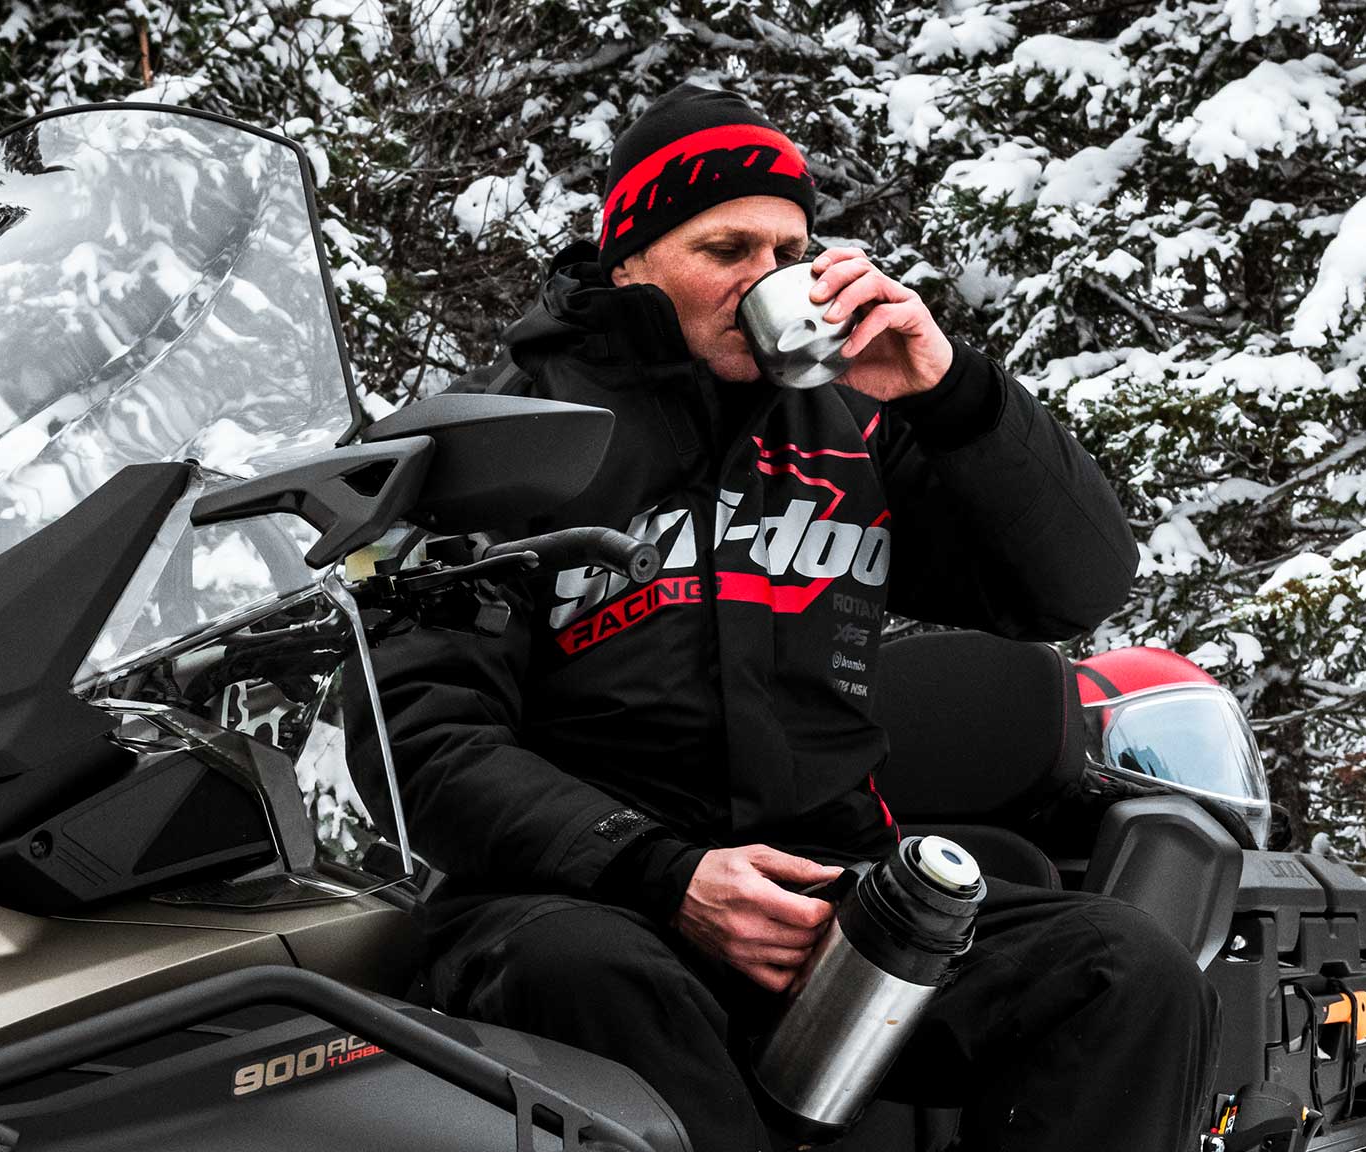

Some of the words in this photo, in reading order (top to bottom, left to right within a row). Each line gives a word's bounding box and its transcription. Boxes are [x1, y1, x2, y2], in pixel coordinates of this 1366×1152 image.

[572, 577, 723, 650] RACING
[833, 593, 881, 621] ROTAX
[233, 1044, 327, 1096] 900
[327, 1034, 371, 1057] AC
